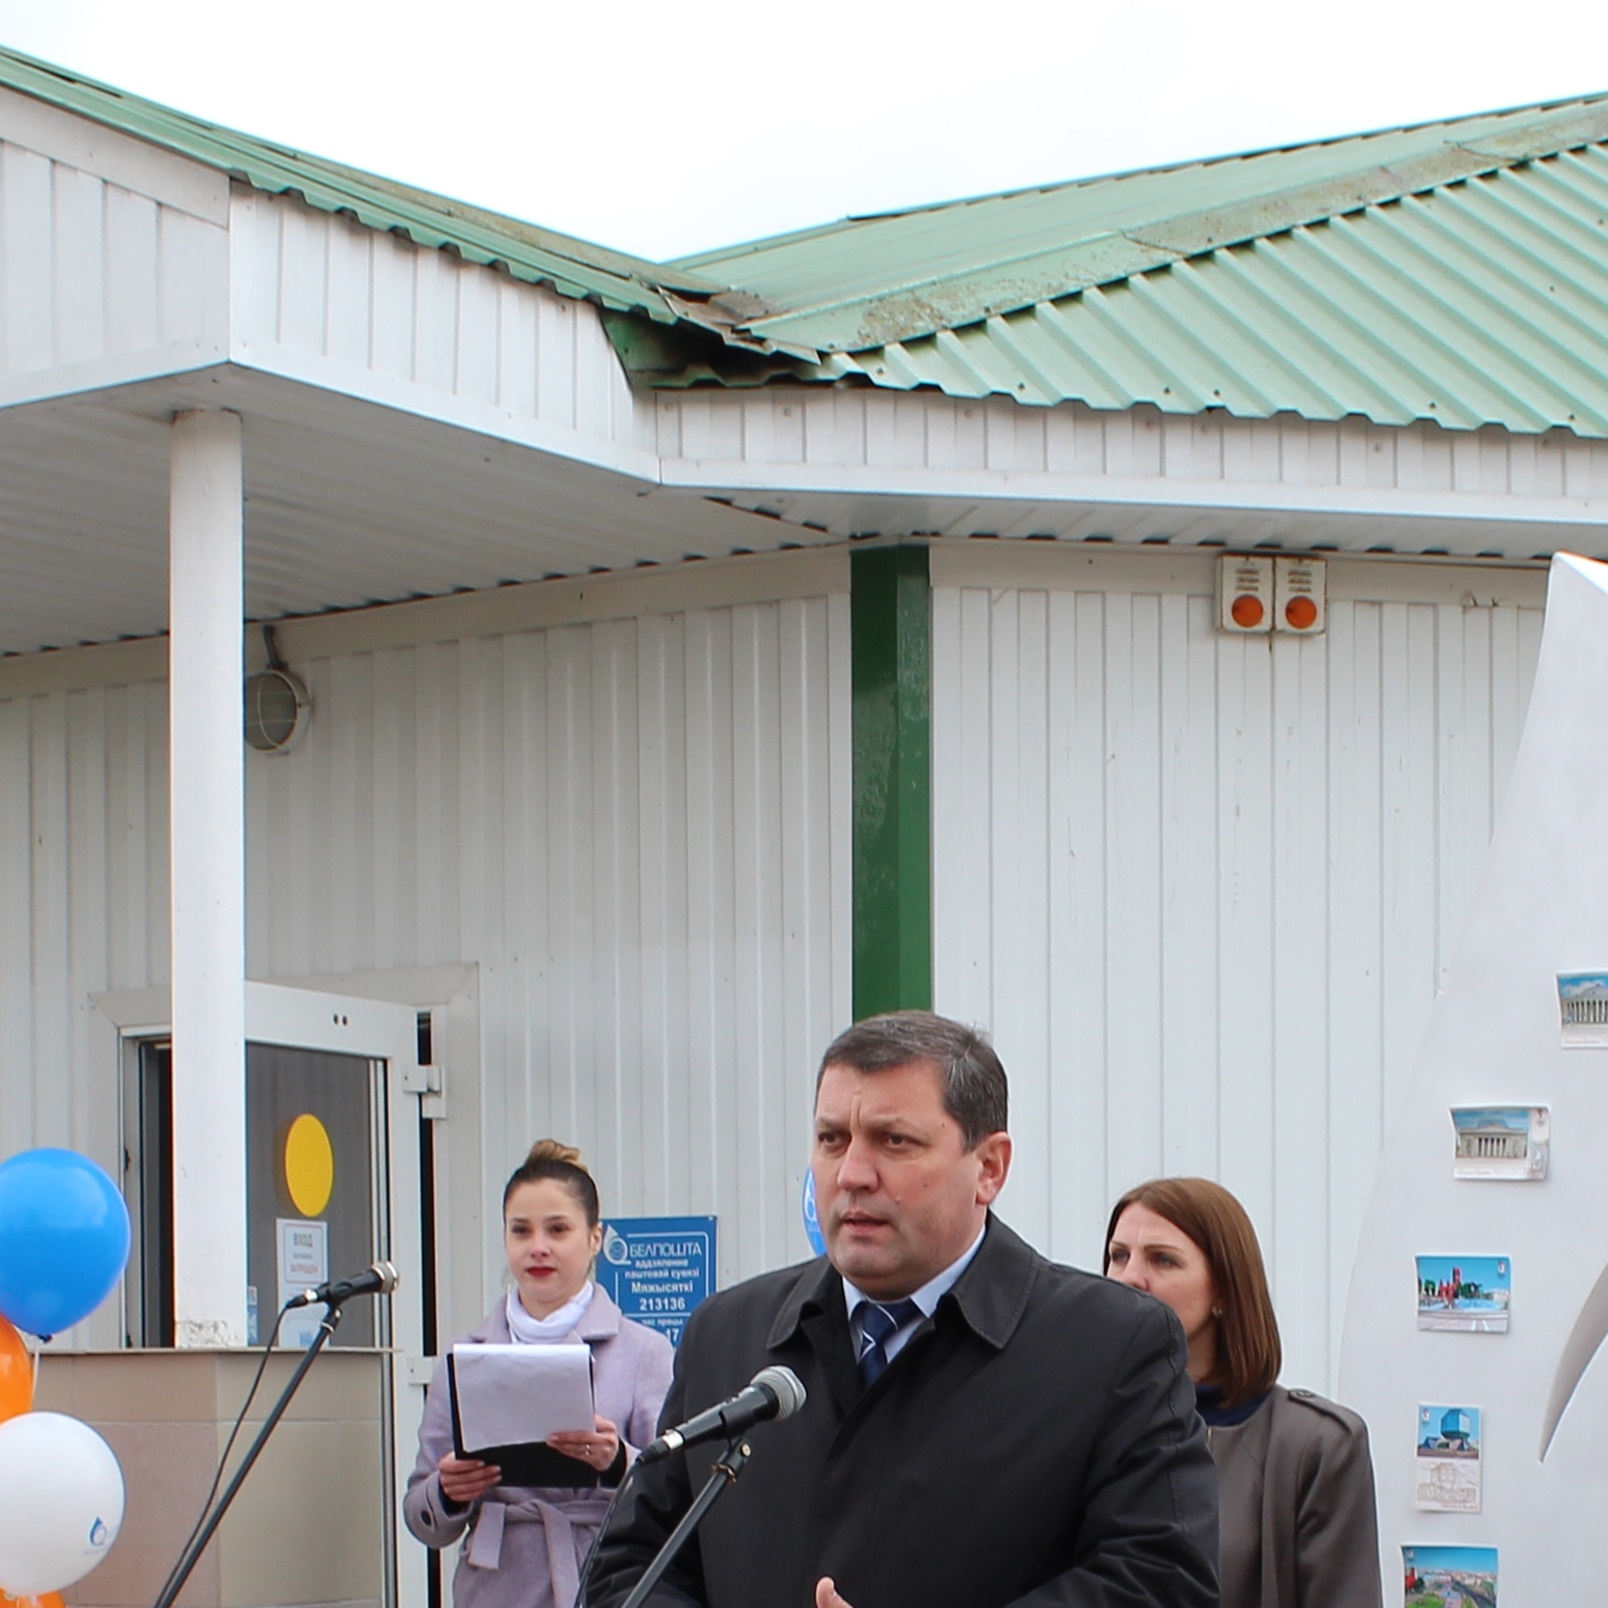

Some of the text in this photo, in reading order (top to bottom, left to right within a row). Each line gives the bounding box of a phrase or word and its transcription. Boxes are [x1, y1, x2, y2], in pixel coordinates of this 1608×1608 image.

[629, 1242, 703, 1258] БЕЛПОШТА
[631, 1280, 694, 1294] Мяжысяткі
[639, 1297, 686, 1312] 213136
